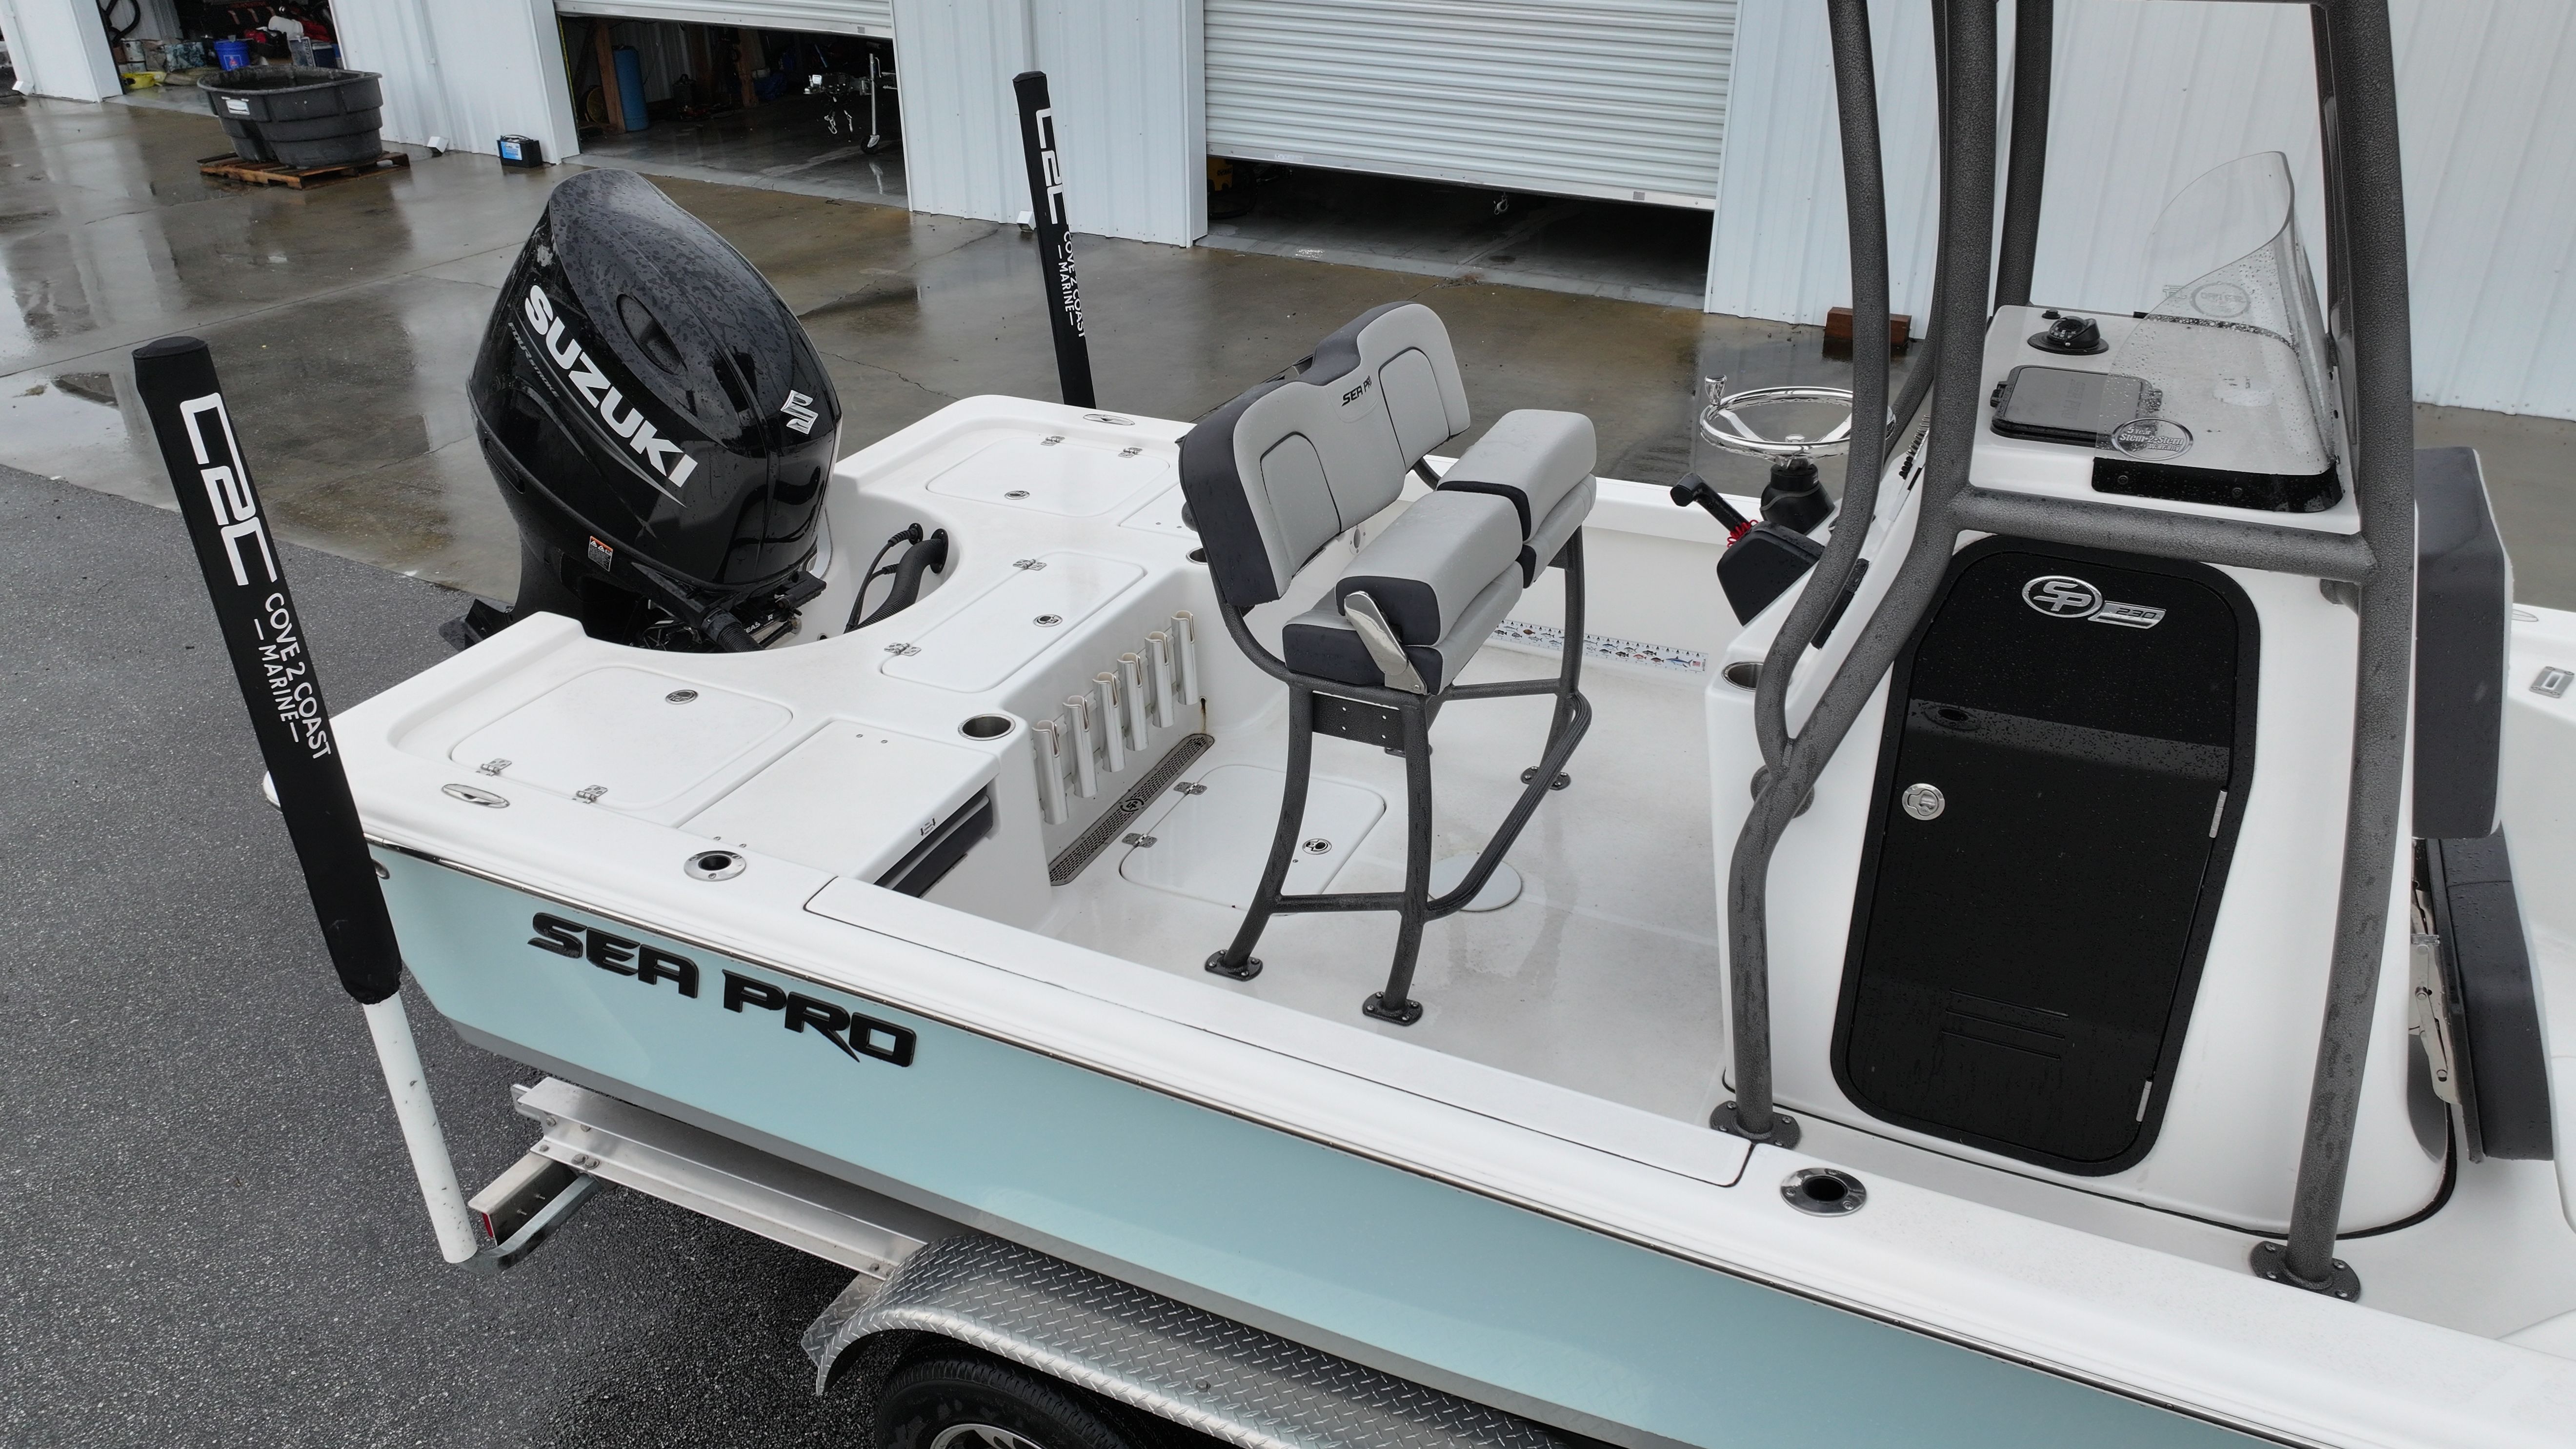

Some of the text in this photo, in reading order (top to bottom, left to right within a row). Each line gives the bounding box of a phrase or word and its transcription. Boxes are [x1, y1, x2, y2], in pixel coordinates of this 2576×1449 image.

[1058, 262, 1074, 312] MARINE
[1064, 231, 1074, 274] COVE
[1073, 288, 1085, 337] COAST
[508, 322, 560, 397] FOUR STROKE
[525, 285, 698, 488] SUZUKI
[1341, 385, 1363, 407] SEA
[2147, 443, 2181, 452] Warranty
[180, 392, 278, 586] C2C
[2033, 581, 2157, 619] SP 230
[259, 644, 299, 722] MARINE
[265, 593, 331, 759] COVE 2 COAST
[527, 912, 917, 1067] SEA PRO
